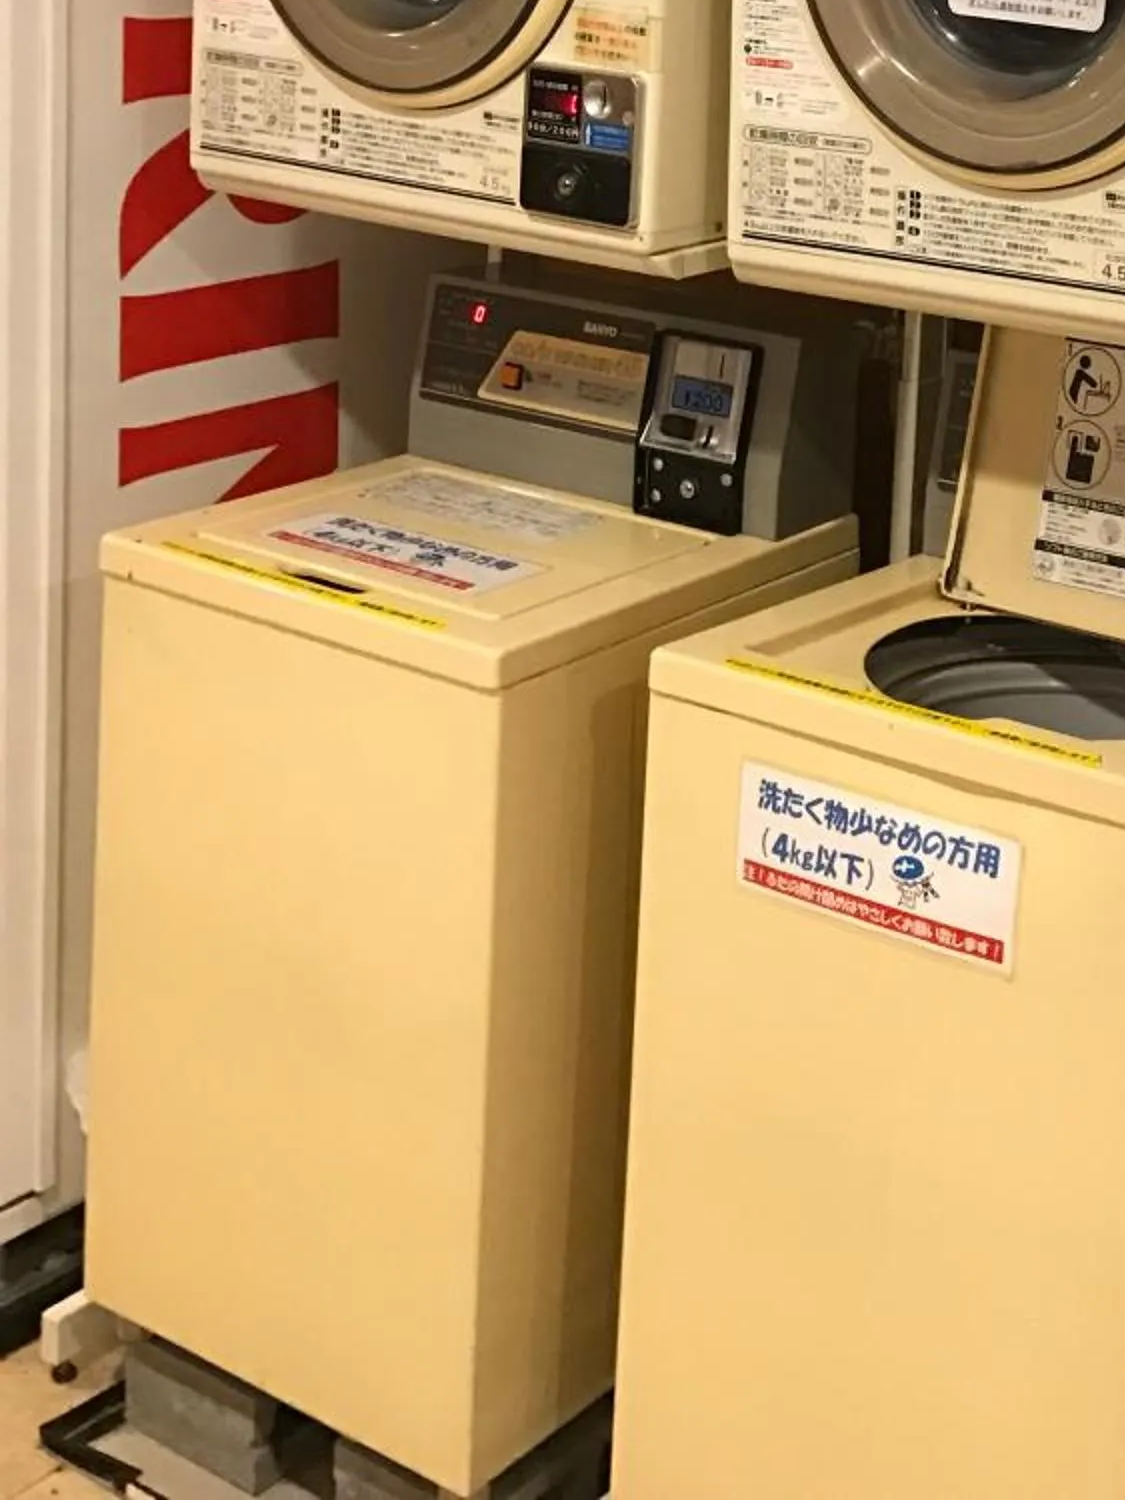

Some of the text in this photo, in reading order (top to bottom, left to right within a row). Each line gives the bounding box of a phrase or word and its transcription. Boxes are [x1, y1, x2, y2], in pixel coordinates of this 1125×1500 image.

[473, 305, 487, 323] 0
[582, 321, 618, 338] SANYO
[758, 778, 1002, 879] 洗たく物少なめの方用
